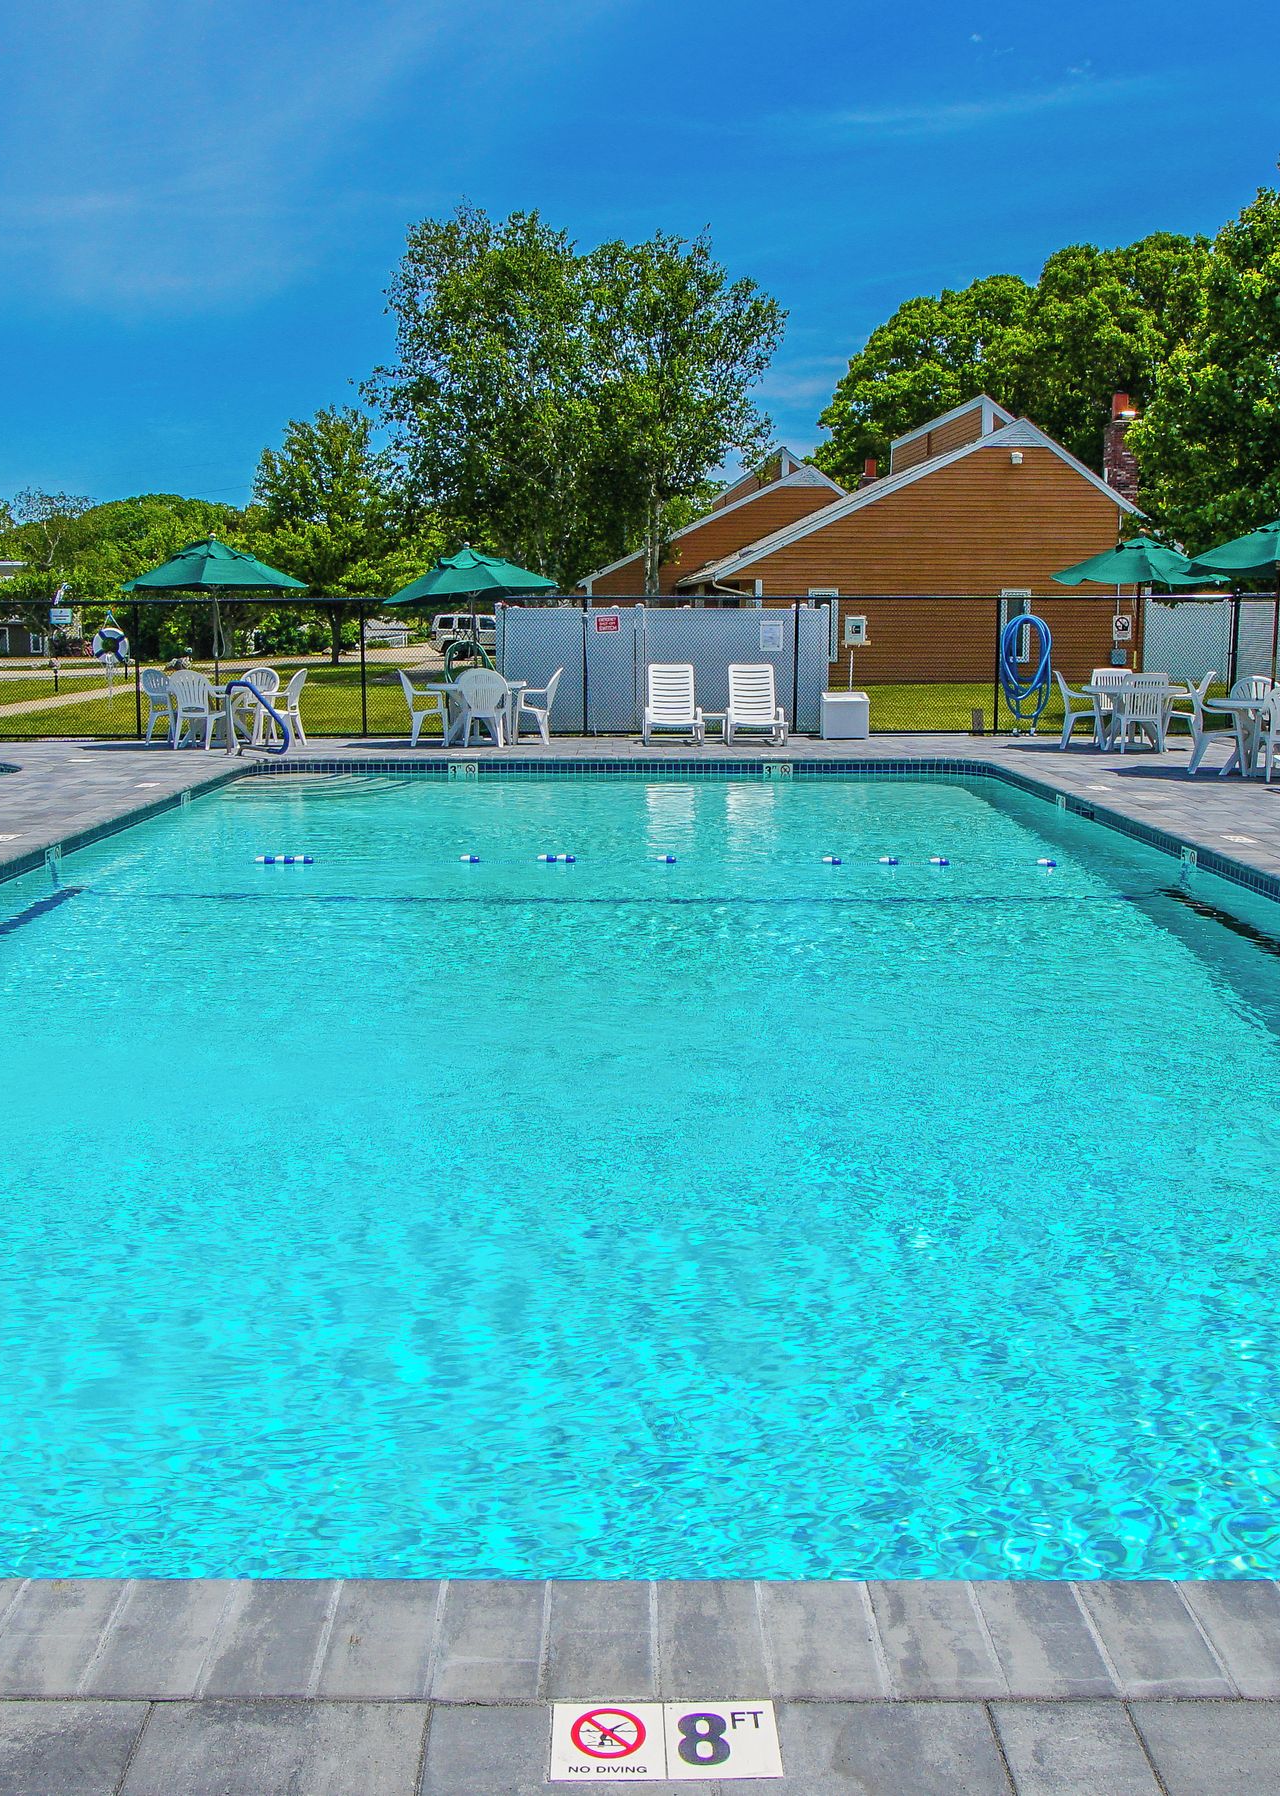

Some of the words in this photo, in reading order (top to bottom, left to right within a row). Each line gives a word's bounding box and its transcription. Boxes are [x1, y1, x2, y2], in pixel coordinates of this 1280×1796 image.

[677, 1712, 731, 1766] 8
[730, 1710, 764, 1730] FT
[568, 1765, 591, 1774] NO
[596, 1765, 648, 1774] DIVING
